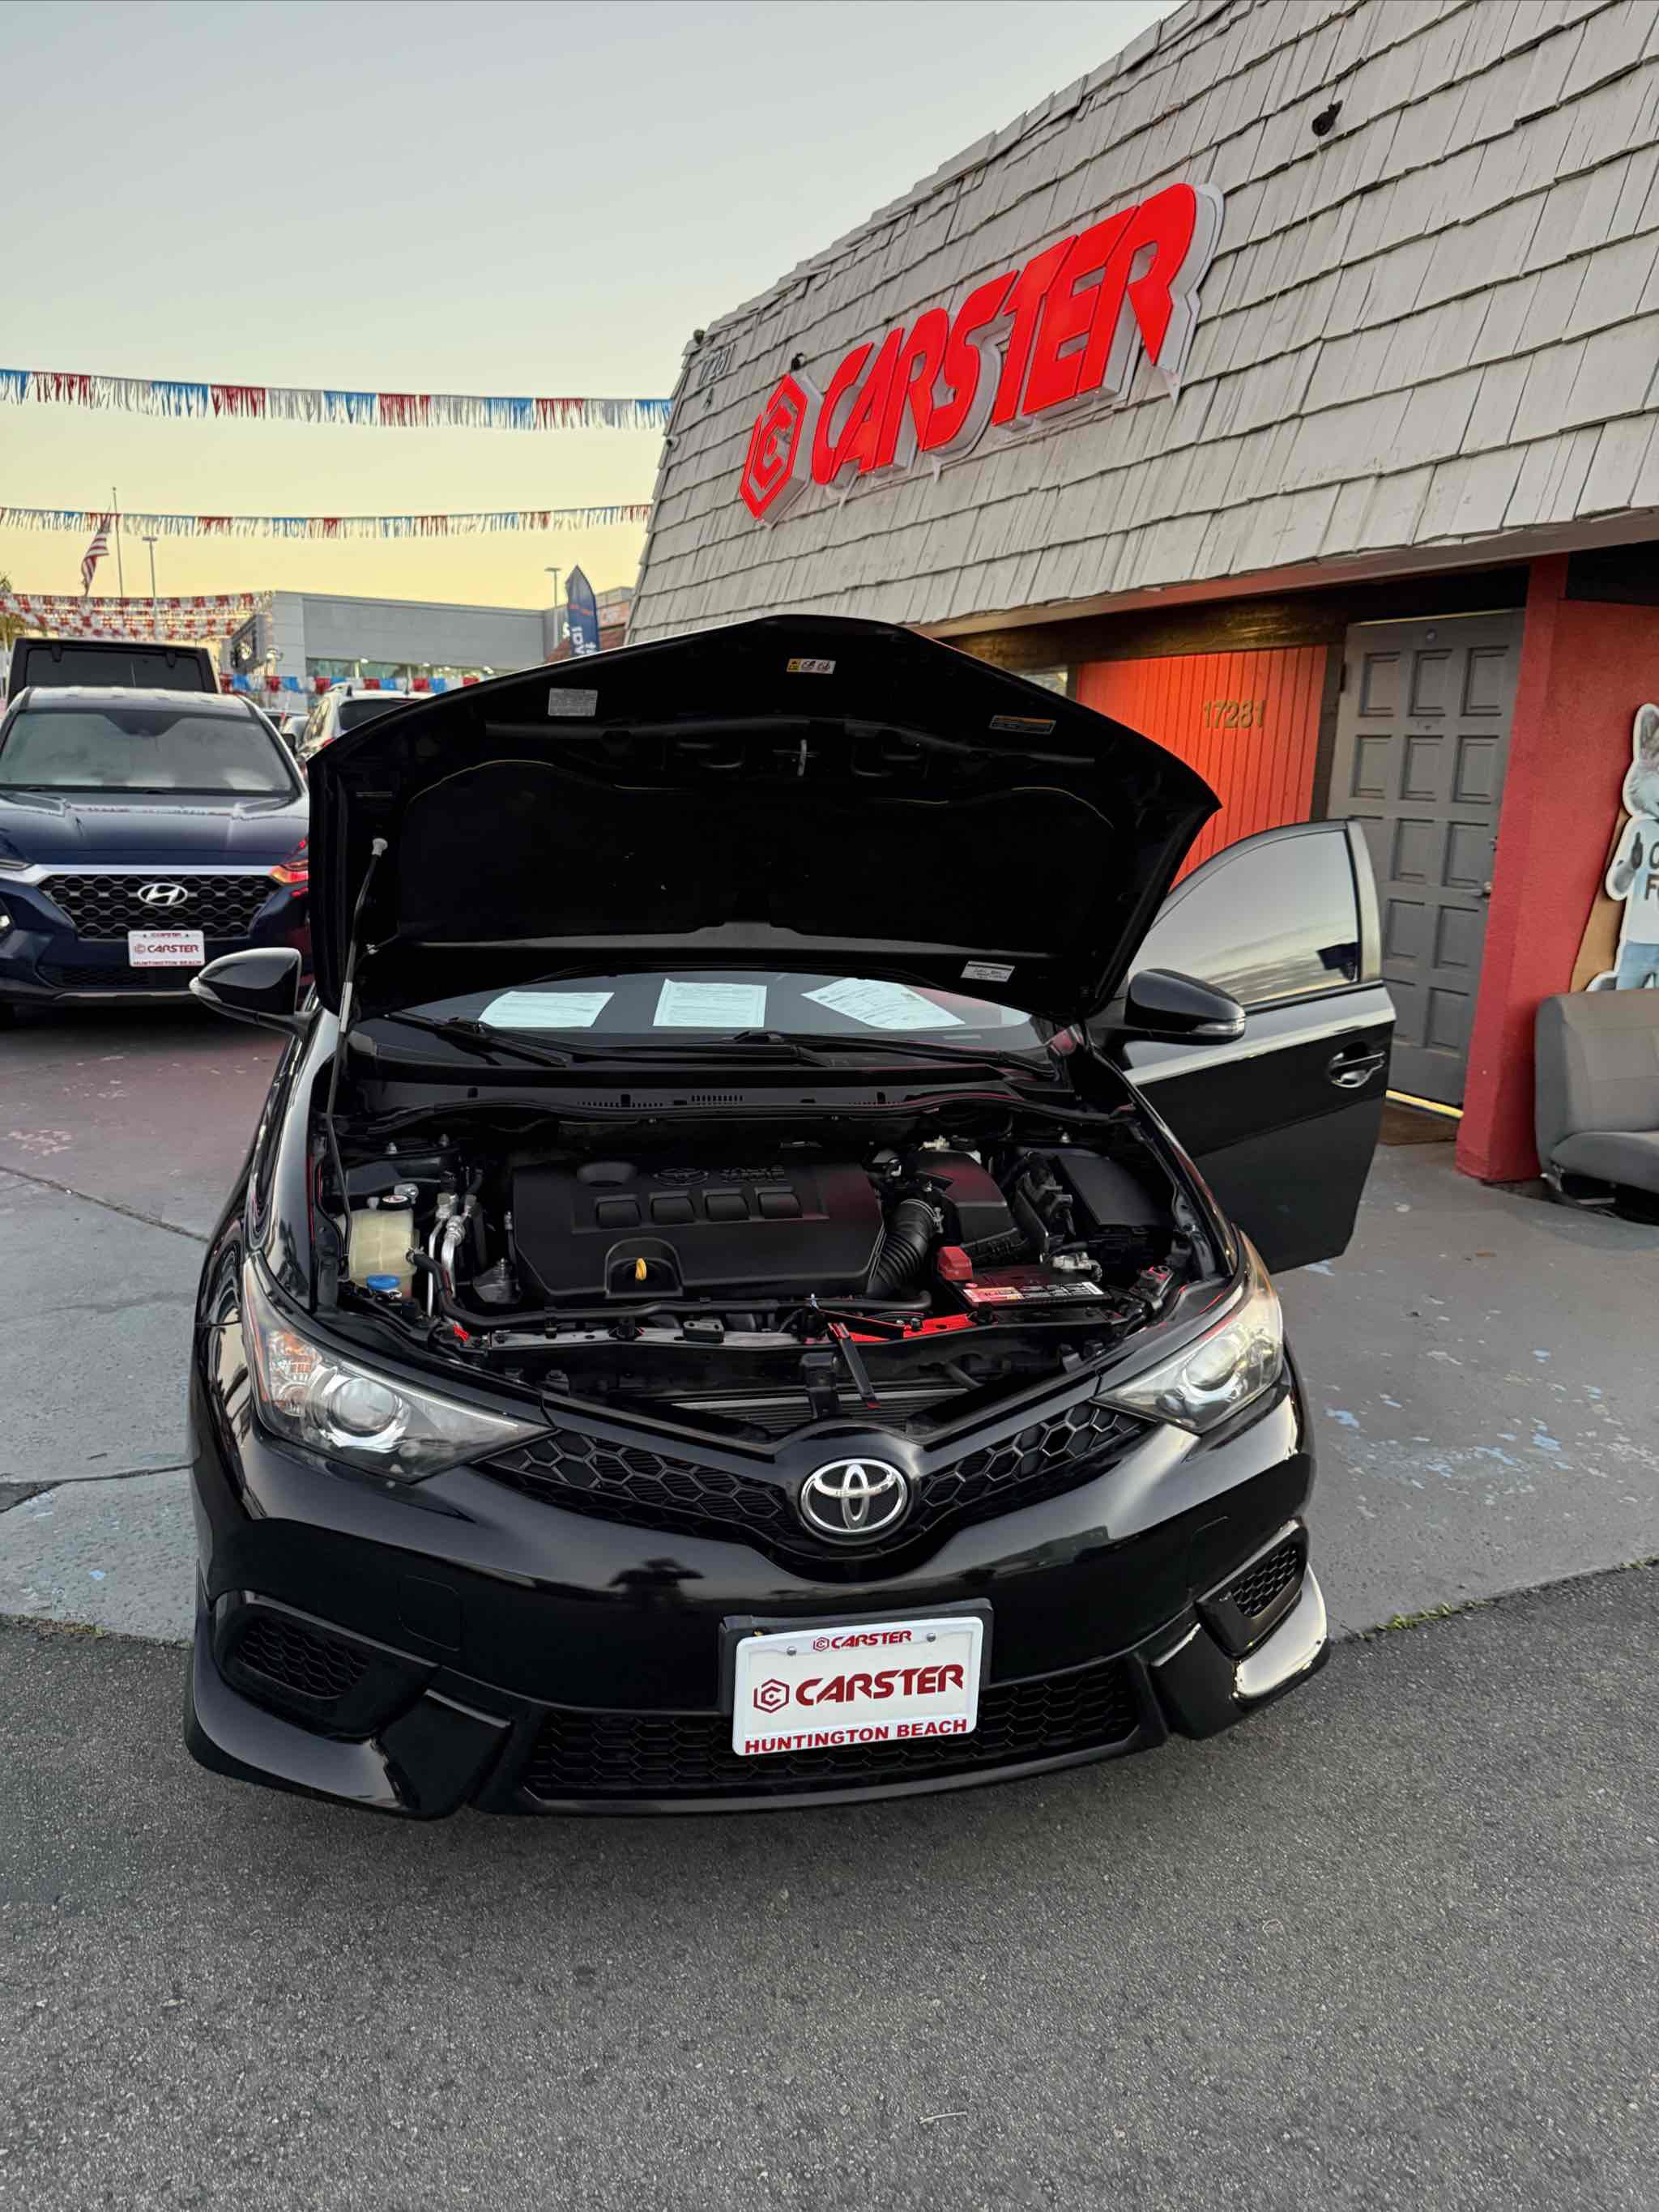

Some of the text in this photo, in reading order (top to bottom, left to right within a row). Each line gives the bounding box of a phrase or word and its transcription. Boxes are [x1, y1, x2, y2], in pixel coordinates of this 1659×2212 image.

[812, 182, 1199, 486] CARSTER
[1205, 700, 1264, 728] 17281
[147, 944, 198, 953] CARSTER
[831, 1630, 913, 1650] CARSTER
[795, 1664, 965, 1707] CARSTER
[744, 1719, 967, 1754] HUNTINGTON BEACH
